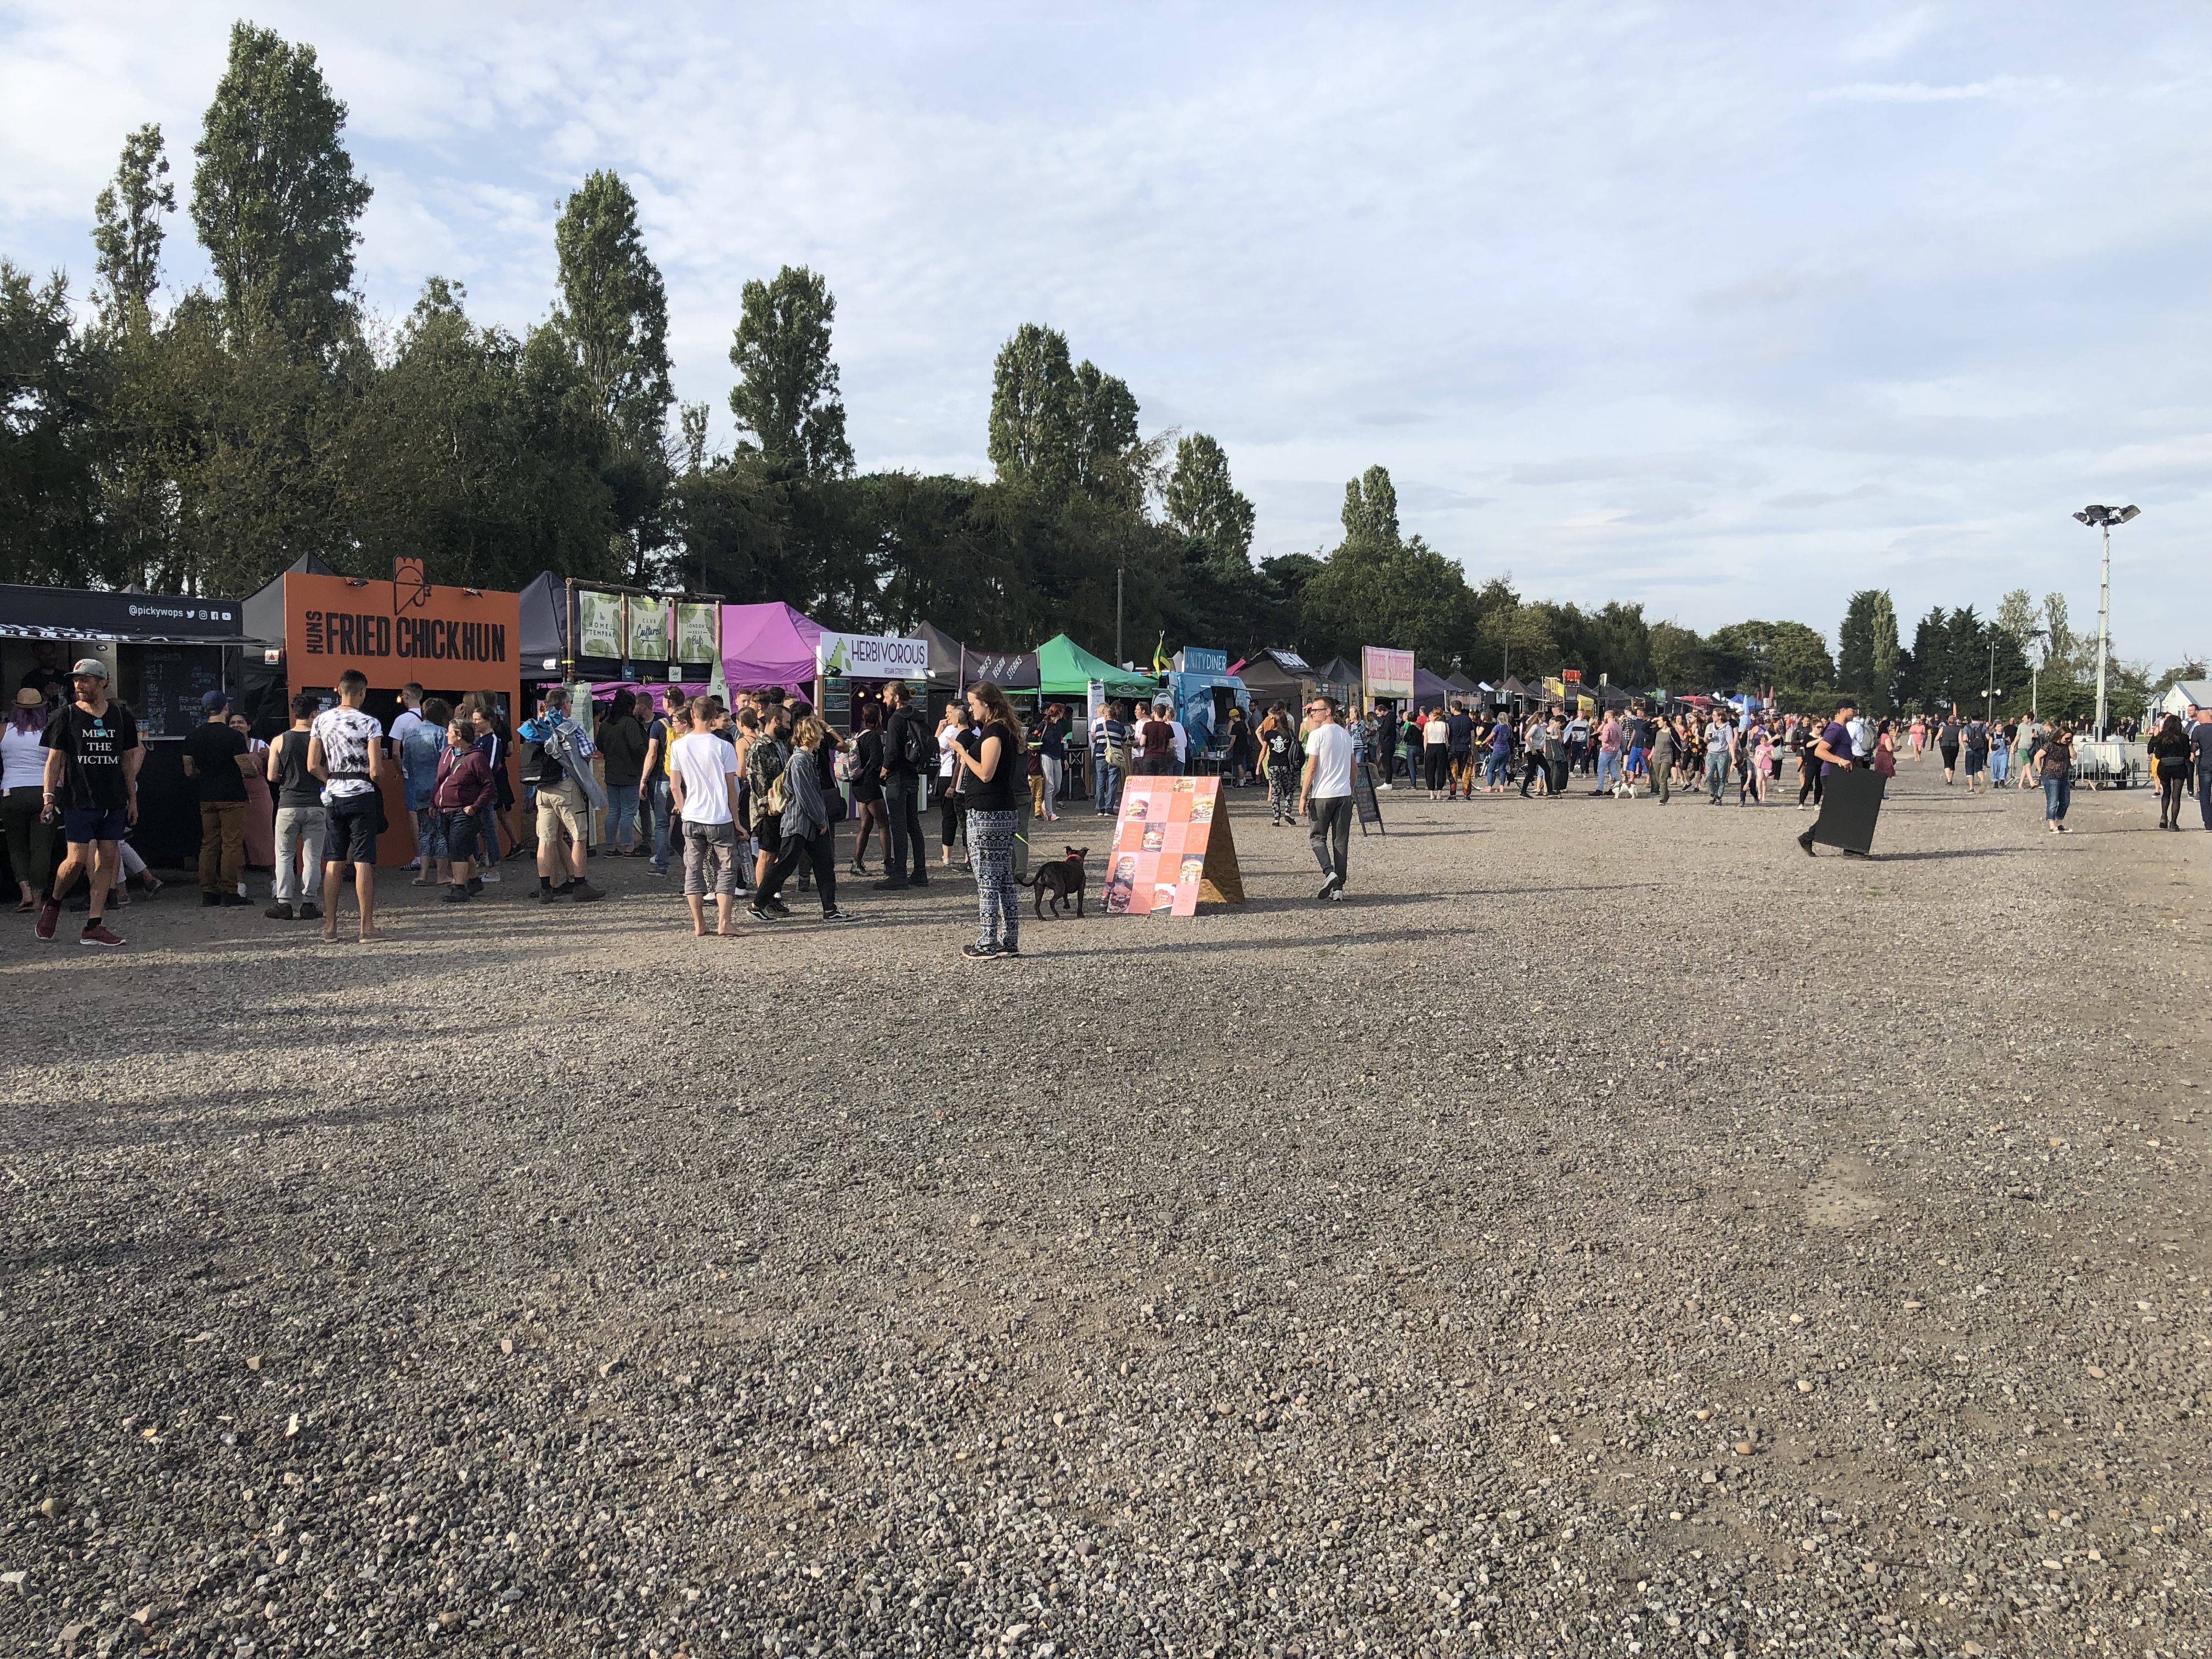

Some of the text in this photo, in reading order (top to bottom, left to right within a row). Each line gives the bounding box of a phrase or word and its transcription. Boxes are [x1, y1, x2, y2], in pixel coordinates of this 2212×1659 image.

[129, 605, 184, 618] @pickywops
[305, 611, 324, 654] HUNS
[325, 612, 506, 662] FRIED CHICKHUN
[851, 640, 925, 665] HERBIVOROUS
[1185, 651, 1226, 672] UNITY DINER
[978, 655, 992, 679] JAKE'S
[991, 656, 1006, 679] VEGAN
[1006, 654, 1023, 681] STEAKS
[86, 742, 112, 751] THE
[1132, 778, 1152, 788] HUNS
[1133, 884, 1154, 894] HUNS
